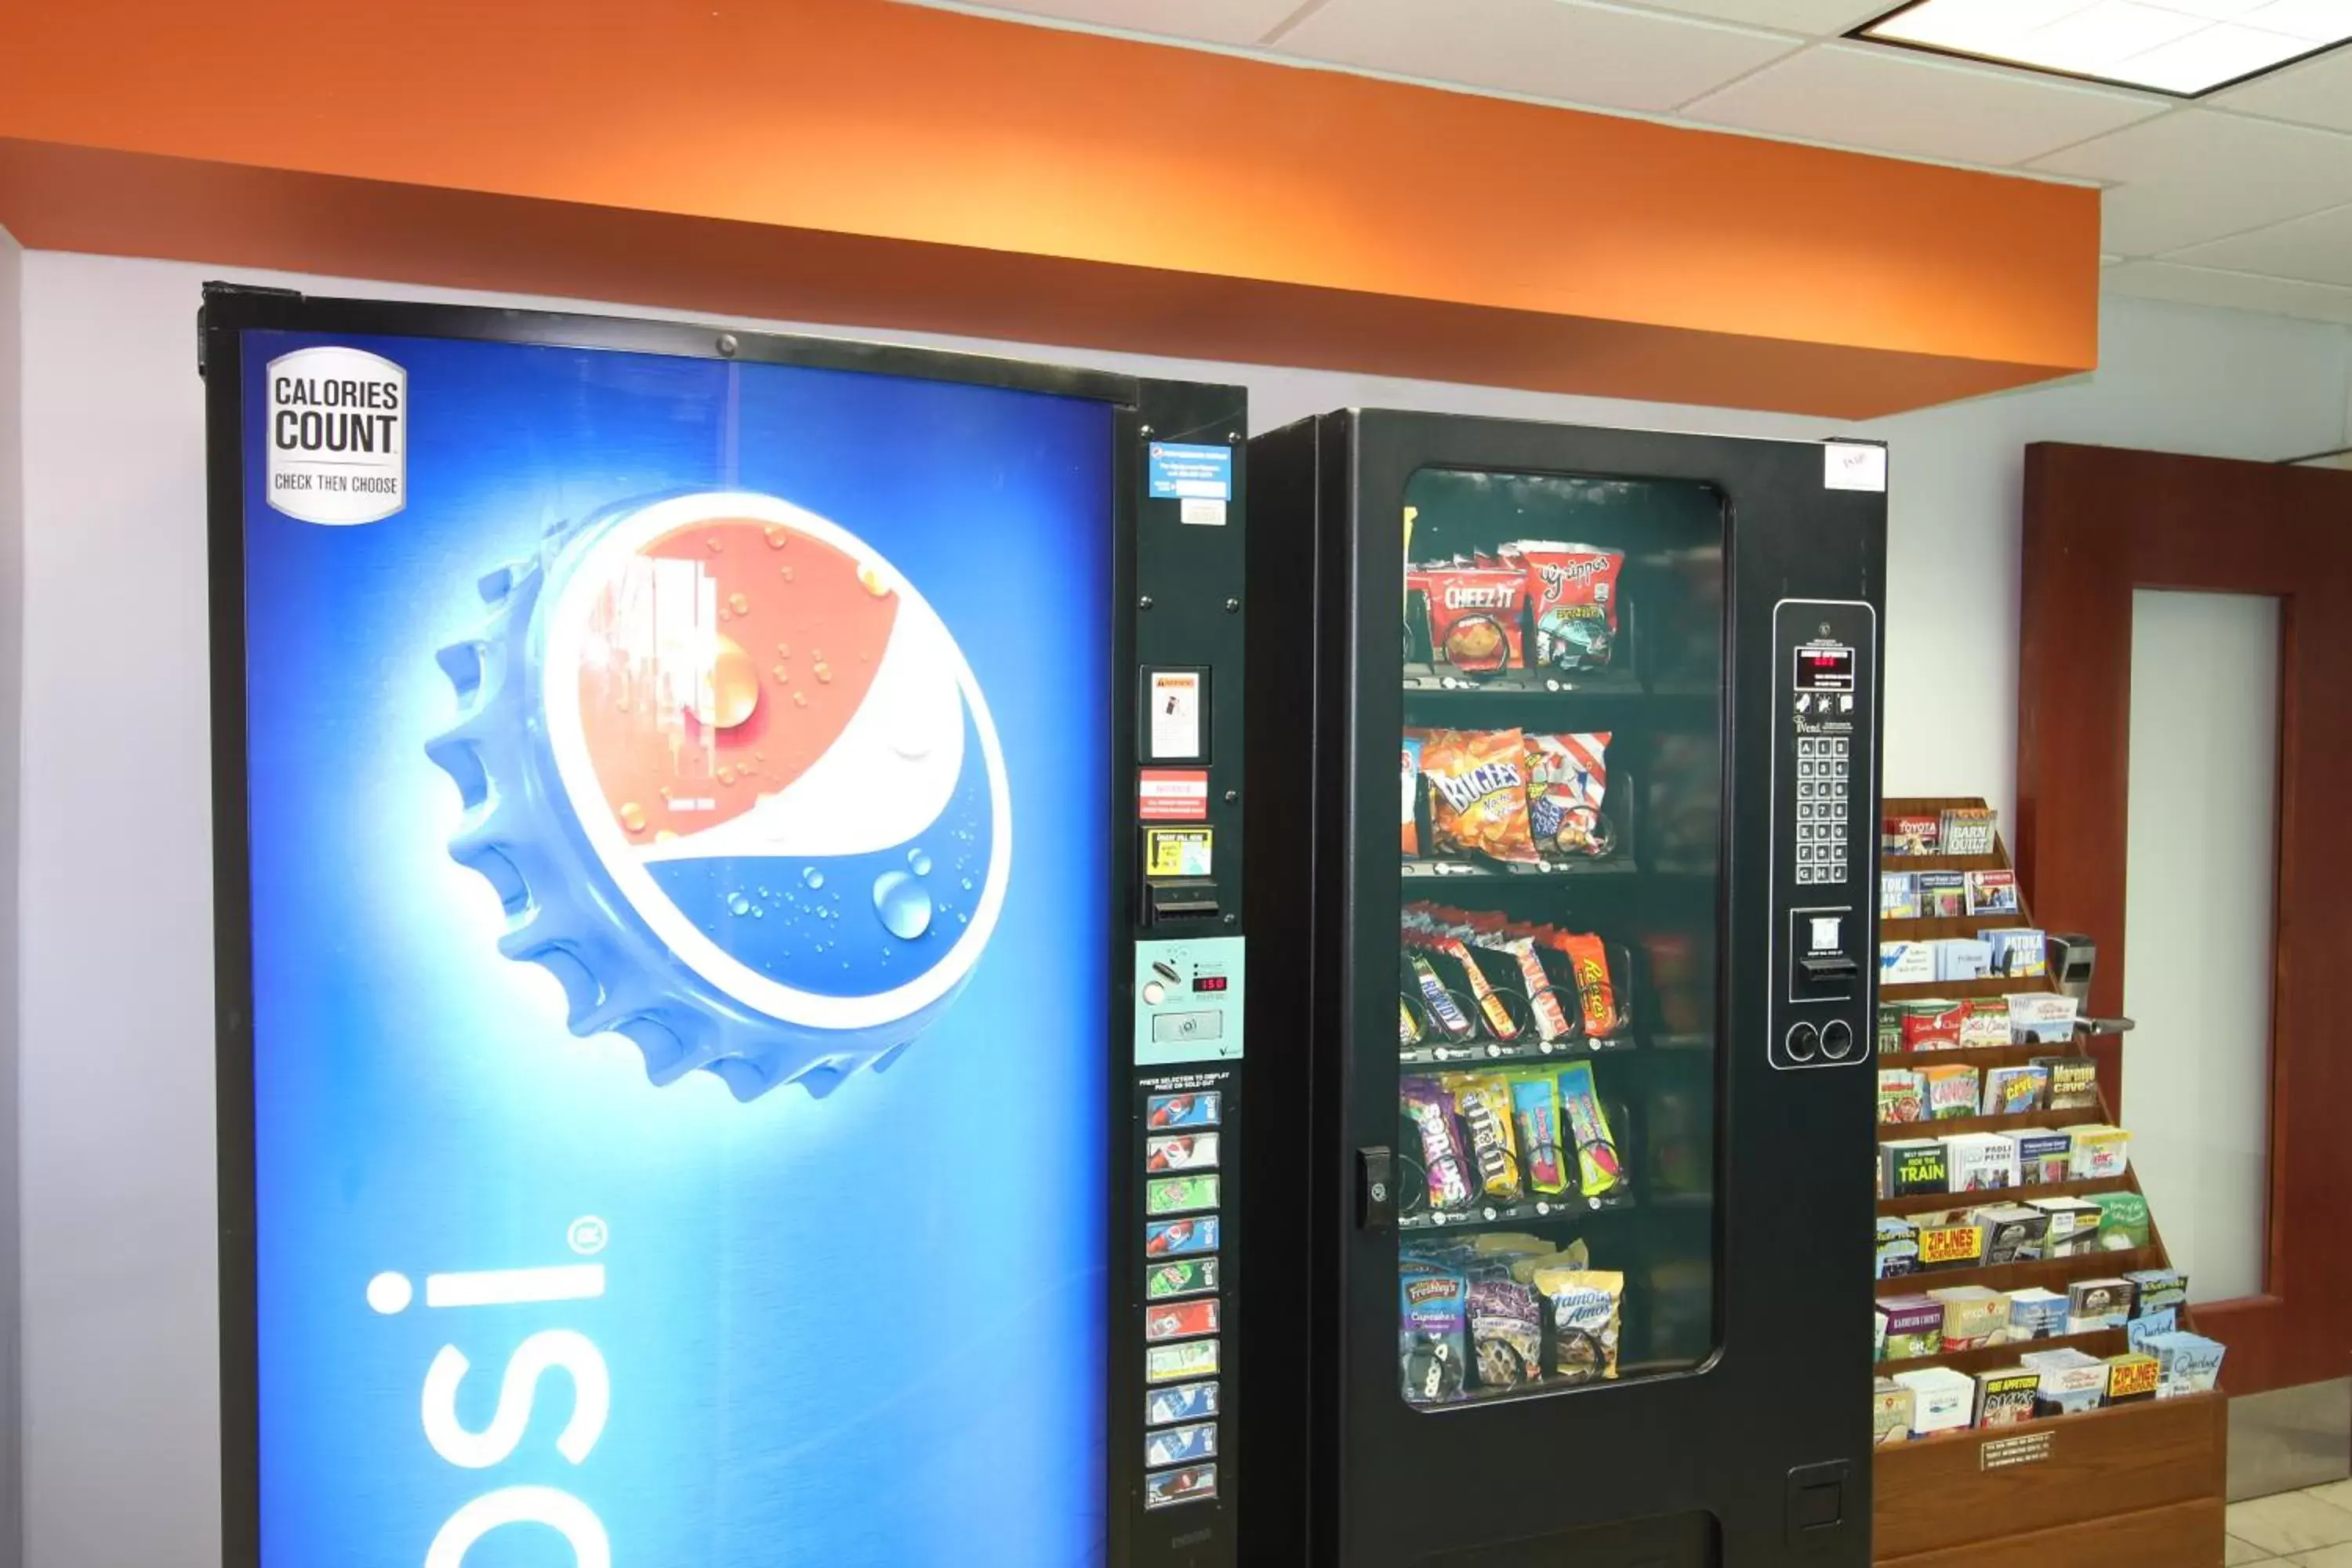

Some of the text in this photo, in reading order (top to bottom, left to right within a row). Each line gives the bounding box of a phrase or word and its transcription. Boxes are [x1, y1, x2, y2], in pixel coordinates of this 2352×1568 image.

[275, 377, 397, 409] CALORIES
[275, 410, 397, 453] COUNT
[275, 474, 397, 494] CHECK THEN CHOOSE
[1438, 762, 1521, 815] BUGLES
[1900, 822, 1937, 833] TOYOTA
[1953, 826, 1986, 837] BARN
[1951, 838, 1987, 851] QUILT
[1882, 877, 1908, 890] TOKA
[2054, 1081, 2085, 1092] cave
[1900, 1165, 1945, 1183] TRAIN
[1929, 1229, 1973, 1250] ZIPLINES
[1552, 1292, 1612, 1308] Famous
[1567, 1305, 1612, 1324] Amos
[1987, 1381, 2003, 1392] FREE
